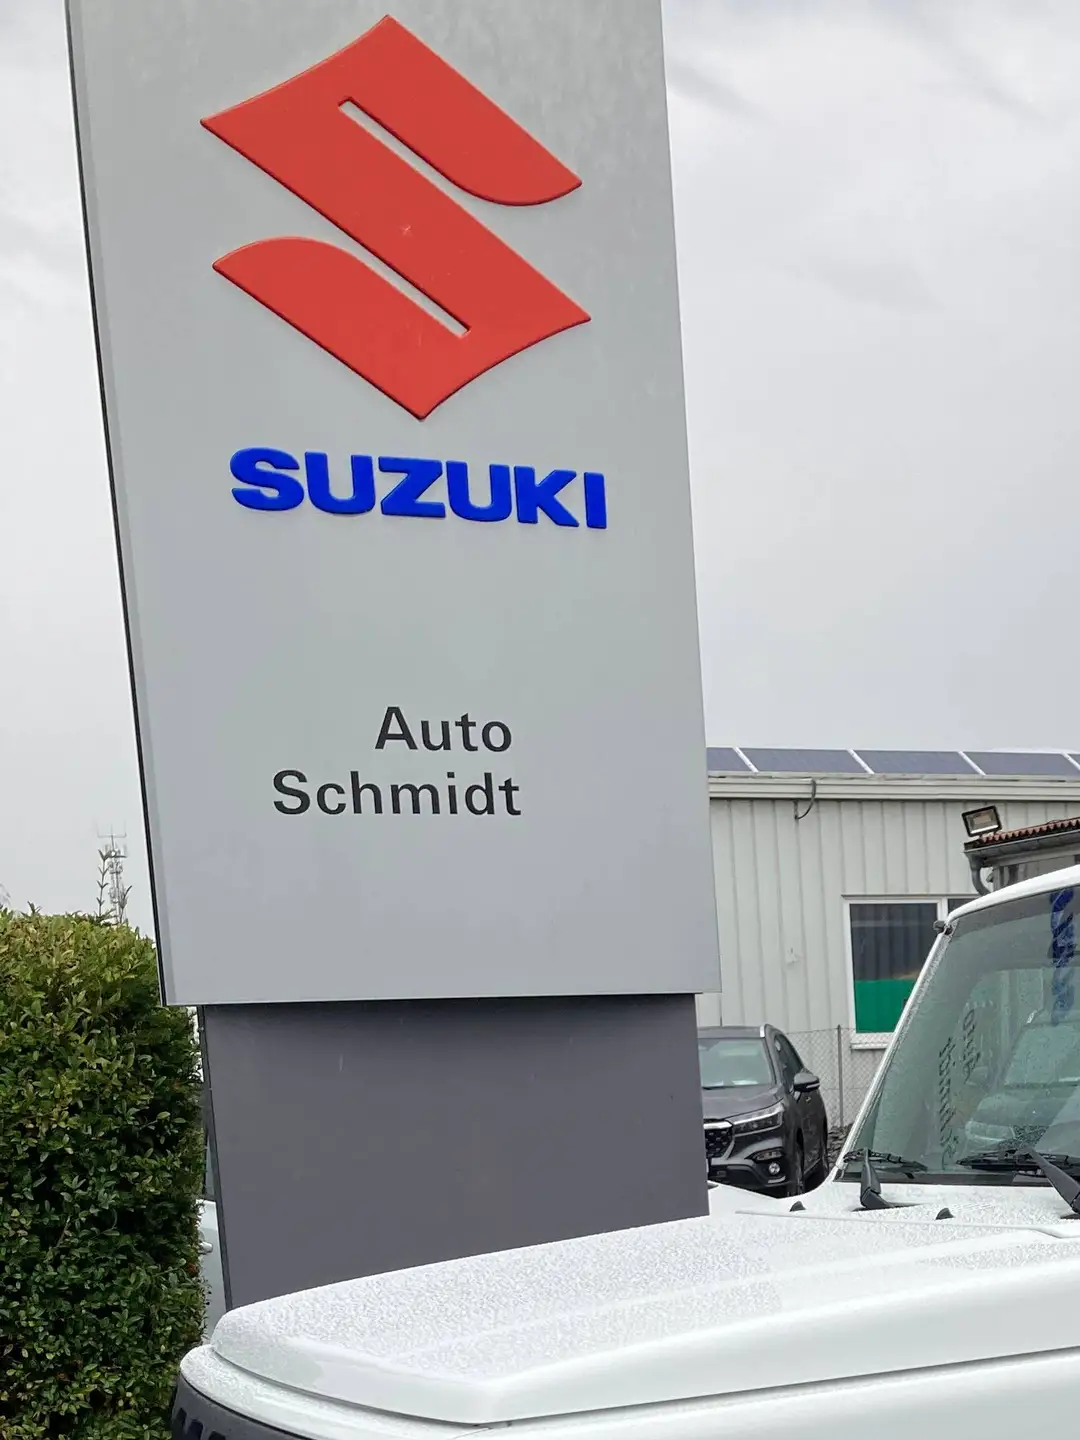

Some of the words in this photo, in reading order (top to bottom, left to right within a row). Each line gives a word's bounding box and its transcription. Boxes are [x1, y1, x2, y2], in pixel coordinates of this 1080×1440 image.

[229, 447, 607, 529] SUZUKI
[374, 705, 513, 752] Auto
[272, 769, 522, 816] Schmidt
